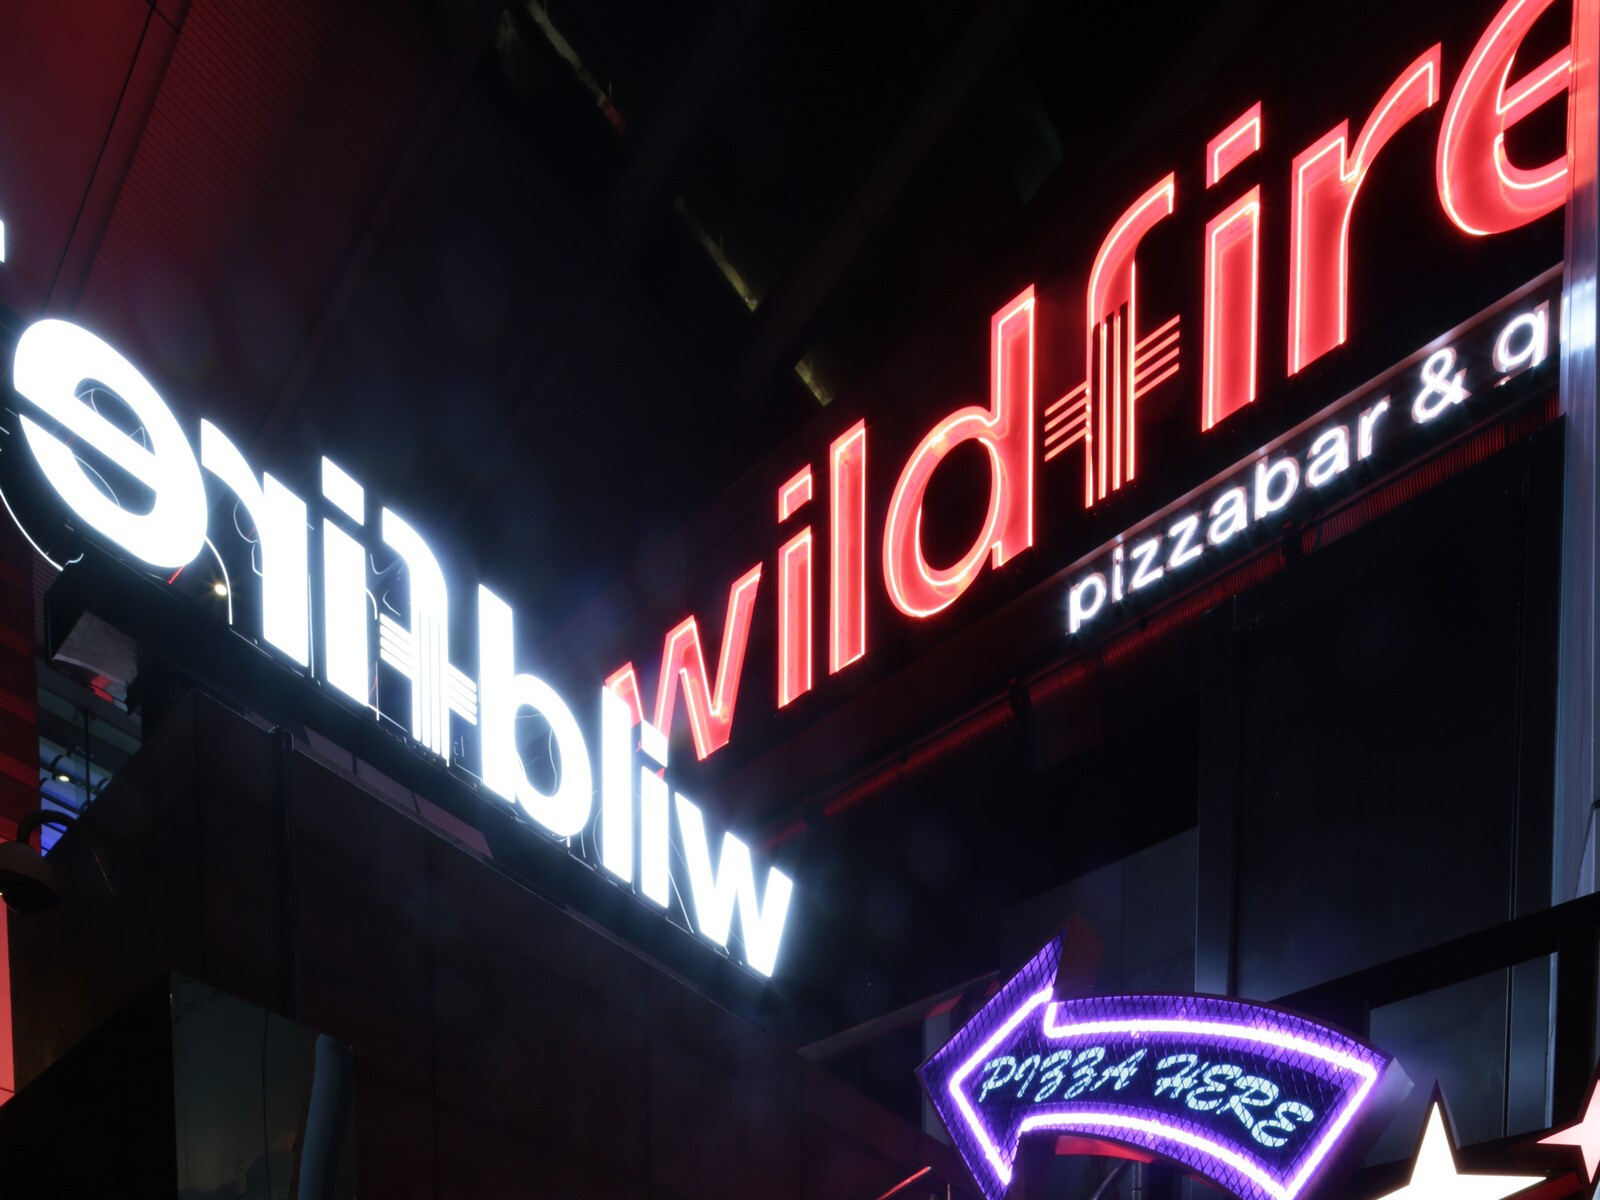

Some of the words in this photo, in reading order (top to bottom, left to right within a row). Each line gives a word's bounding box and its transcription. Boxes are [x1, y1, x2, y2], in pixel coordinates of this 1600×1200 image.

[604, 0, 1576, 762] wildfire
[1067, 394, 1391, 634] pizzabar
[1411, 346, 1472, 424] &
[978, 1046, 1147, 1103] PIZZA
[1154, 1052, 1315, 1149] HERE
